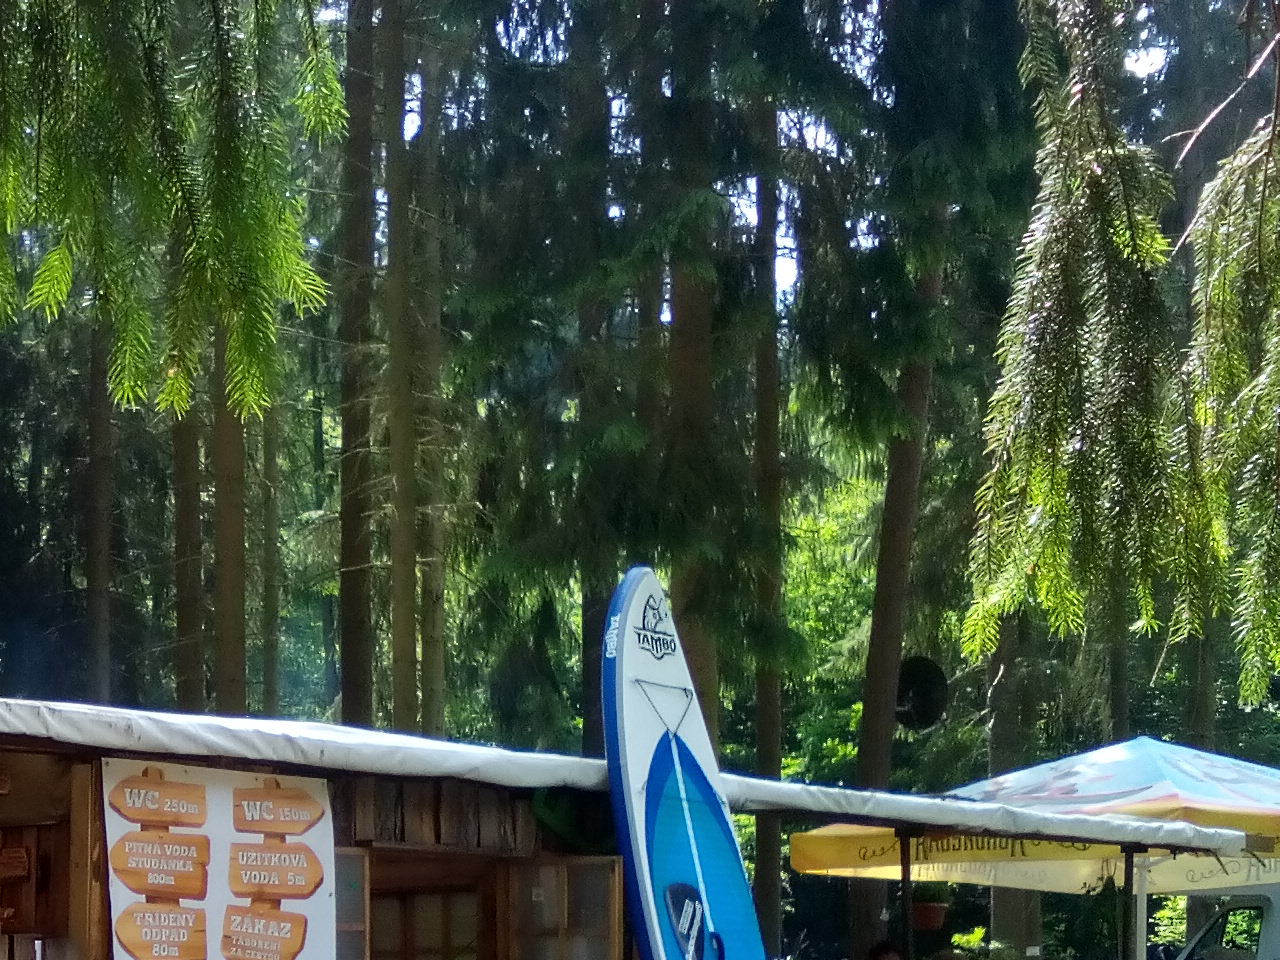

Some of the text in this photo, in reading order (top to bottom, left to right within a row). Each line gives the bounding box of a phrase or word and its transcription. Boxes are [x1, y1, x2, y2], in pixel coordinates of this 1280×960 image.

[637, 633, 676, 653] TAMBO
[124, 788, 200, 814] WC 250m
[241, 800, 312, 821] WC 150m
[164, 844, 197, 857] VODA
[241, 870, 305, 886] VODA 5m
[230, 914, 292, 938] ZÁKAZ
[142, 927, 188, 942] ODPAD
[152, 943, 179, 956] 80m
[230, 947, 243, 957] ZA
